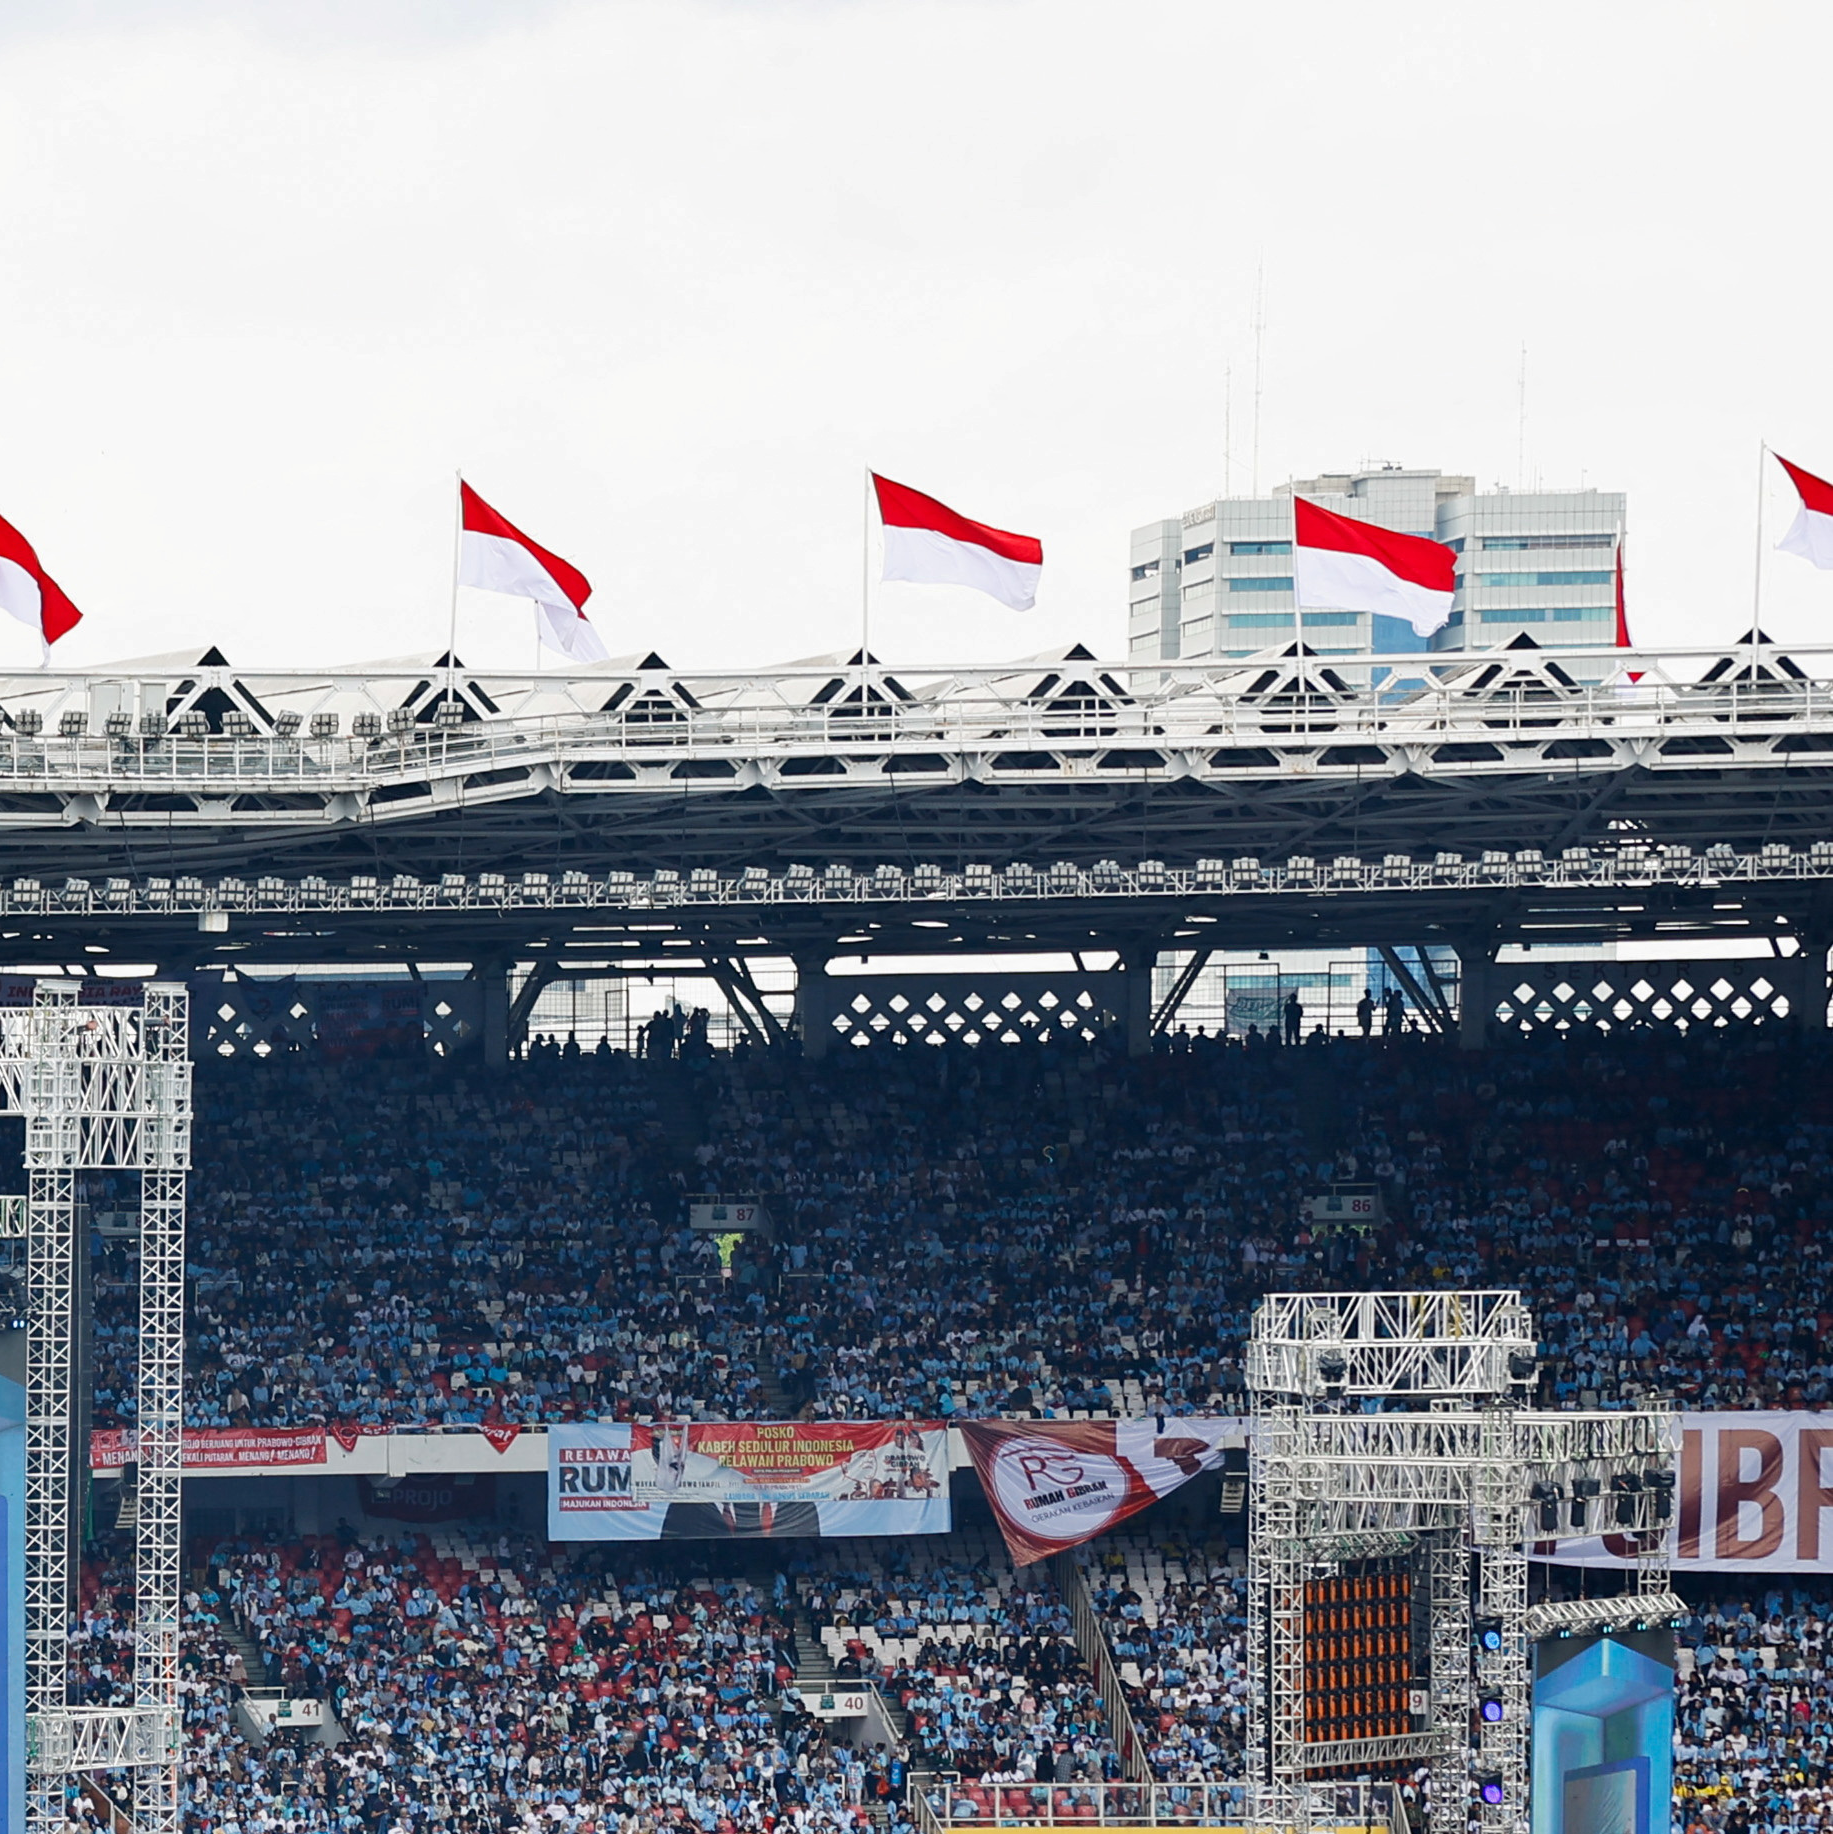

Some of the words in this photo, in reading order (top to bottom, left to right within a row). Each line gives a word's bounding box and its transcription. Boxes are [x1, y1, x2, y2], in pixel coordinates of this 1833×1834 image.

[1543, 961, 1690, 979] SEKTOR
[1351, 1200, 1371, 1212] 86
[736, 1208, 754, 1220] 87
[757, 1426, 795, 1439] POSKO
[182, 1438, 200, 1449] ROJO
[201, 1439, 234, 1449] BERJUANG
[235, 1438, 256, 1448] UNTUK
[257, 1435, 322, 1448] PRABOWO-GIBRAN
[698, 1440, 735, 1454] KABEH
[738, 1440, 791, 1453] SEDULUR
[793, 1439, 854, 1453] INDONESIA
[102, 1450, 139, 1466] MENAN
[182, 1452, 204, 1463] EKALI
[564, 1449, 632, 1462] RELAWA
[718, 1454, 775, 1468] RELAWAN
[777, 1453, 834, 1467] PRABOWO
[559, 1465, 632, 1494] RUM
[1023, 1489, 1066, 1511] RUMAH
[1066, 1480, 1109, 1499] GIBRAN
[562, 1499, 600, 1509] MAJUKAN
[1031, 1506, 1072, 1523] GERAKAN
[1072, 1492, 1115, 1512] KEBAIKAN
[302, 1702, 321, 1716] 41
[843, 1696, 864, 1710] 40
